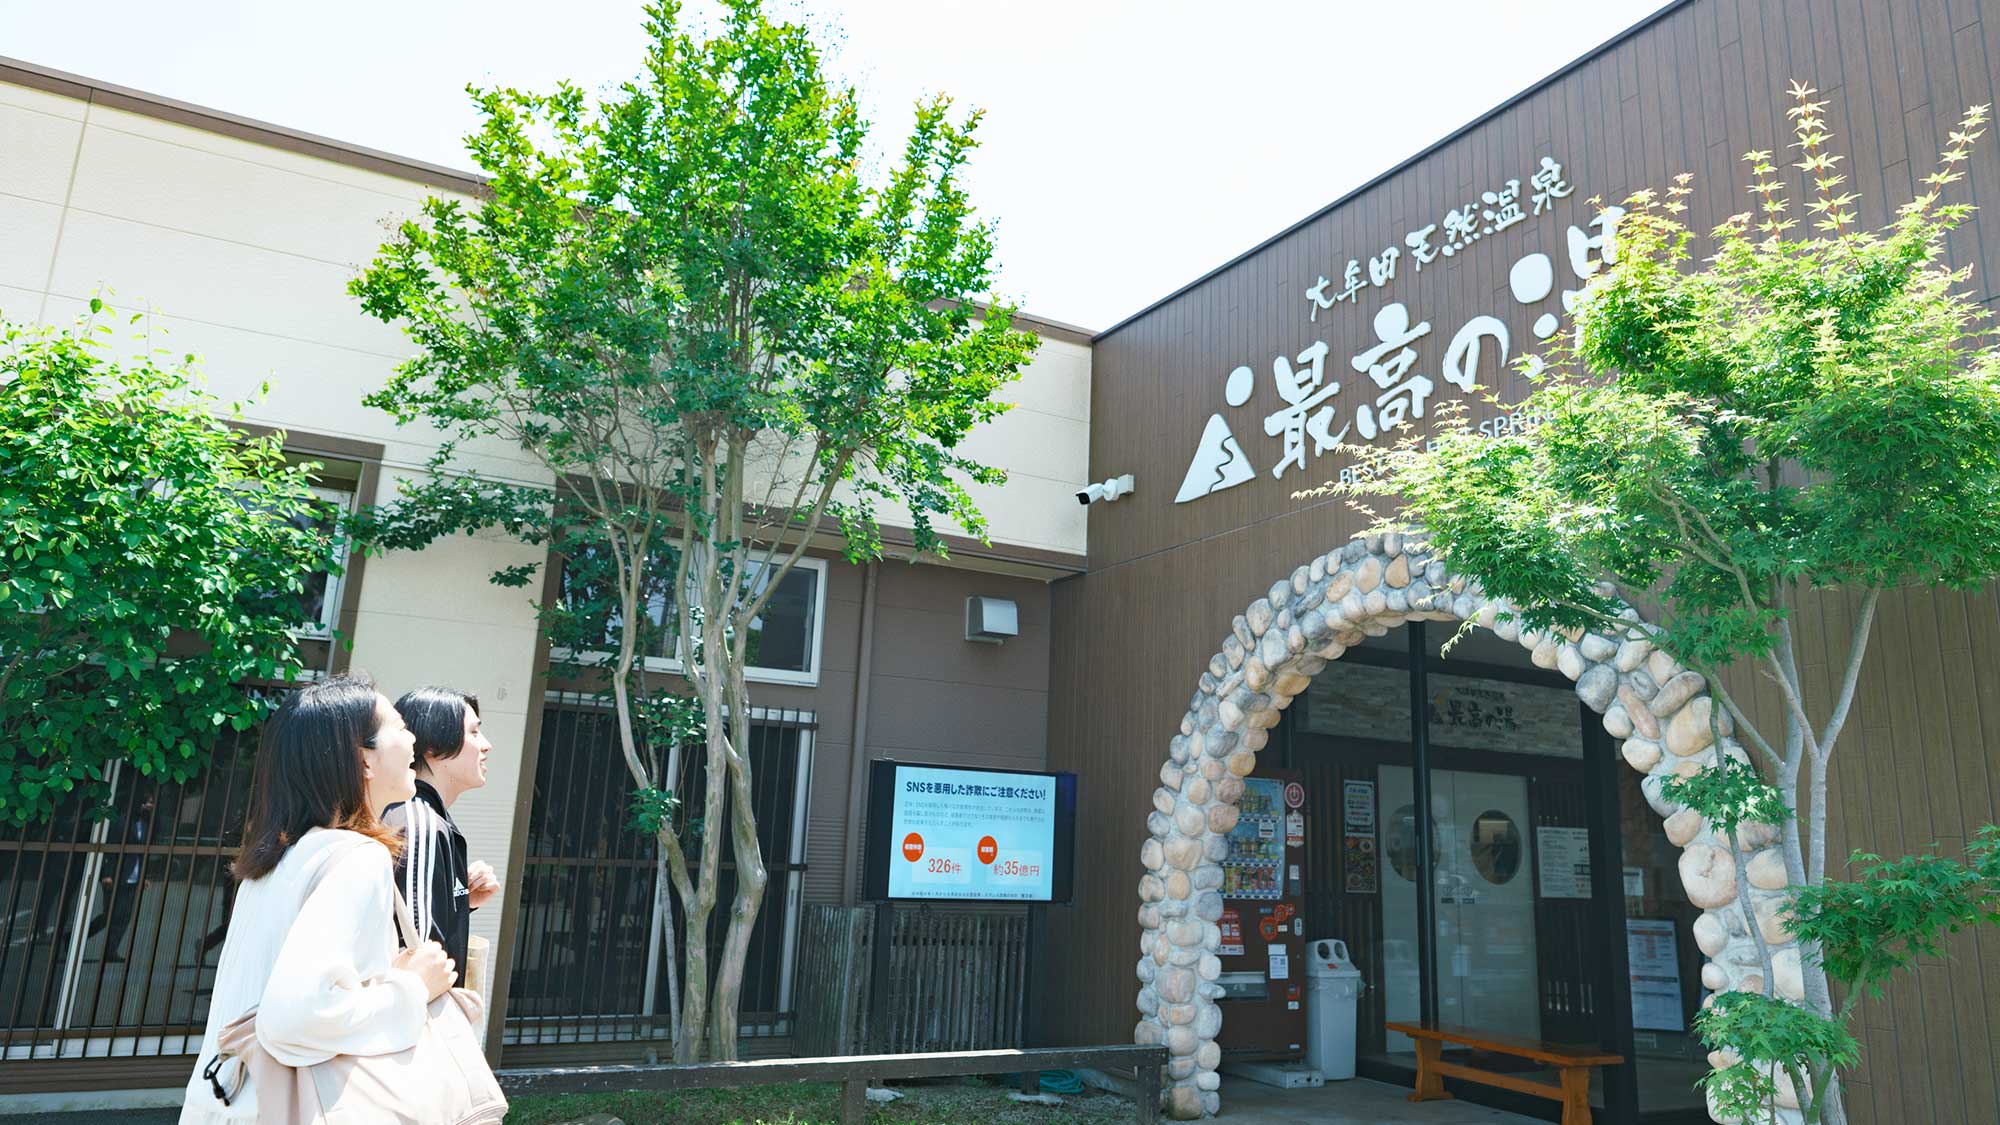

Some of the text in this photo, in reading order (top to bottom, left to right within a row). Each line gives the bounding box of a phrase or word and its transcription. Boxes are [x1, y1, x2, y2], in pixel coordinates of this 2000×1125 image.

[1305, 156, 1575, 322] 大牟田天然温泉
[928, 858, 962, 875] 326件
[993, 861, 1040, 877] 約35億円
